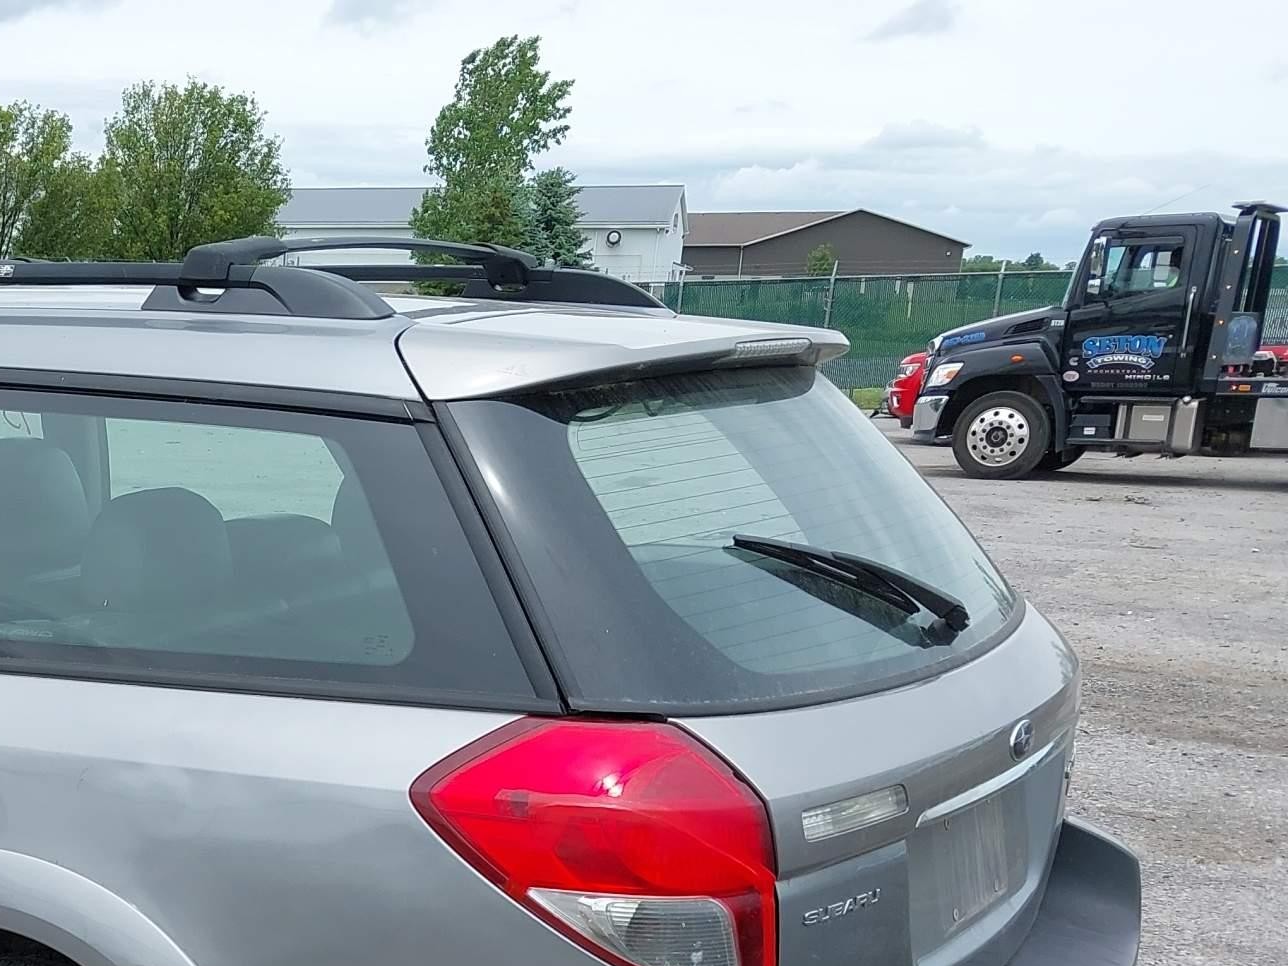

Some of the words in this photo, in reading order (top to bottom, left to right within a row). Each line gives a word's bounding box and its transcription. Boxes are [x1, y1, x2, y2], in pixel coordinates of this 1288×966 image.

[1082, 335, 1168, 358] SETON
[1095, 354, 1147, 364] TOWING
[802, 888, 881, 926] SUBARU
